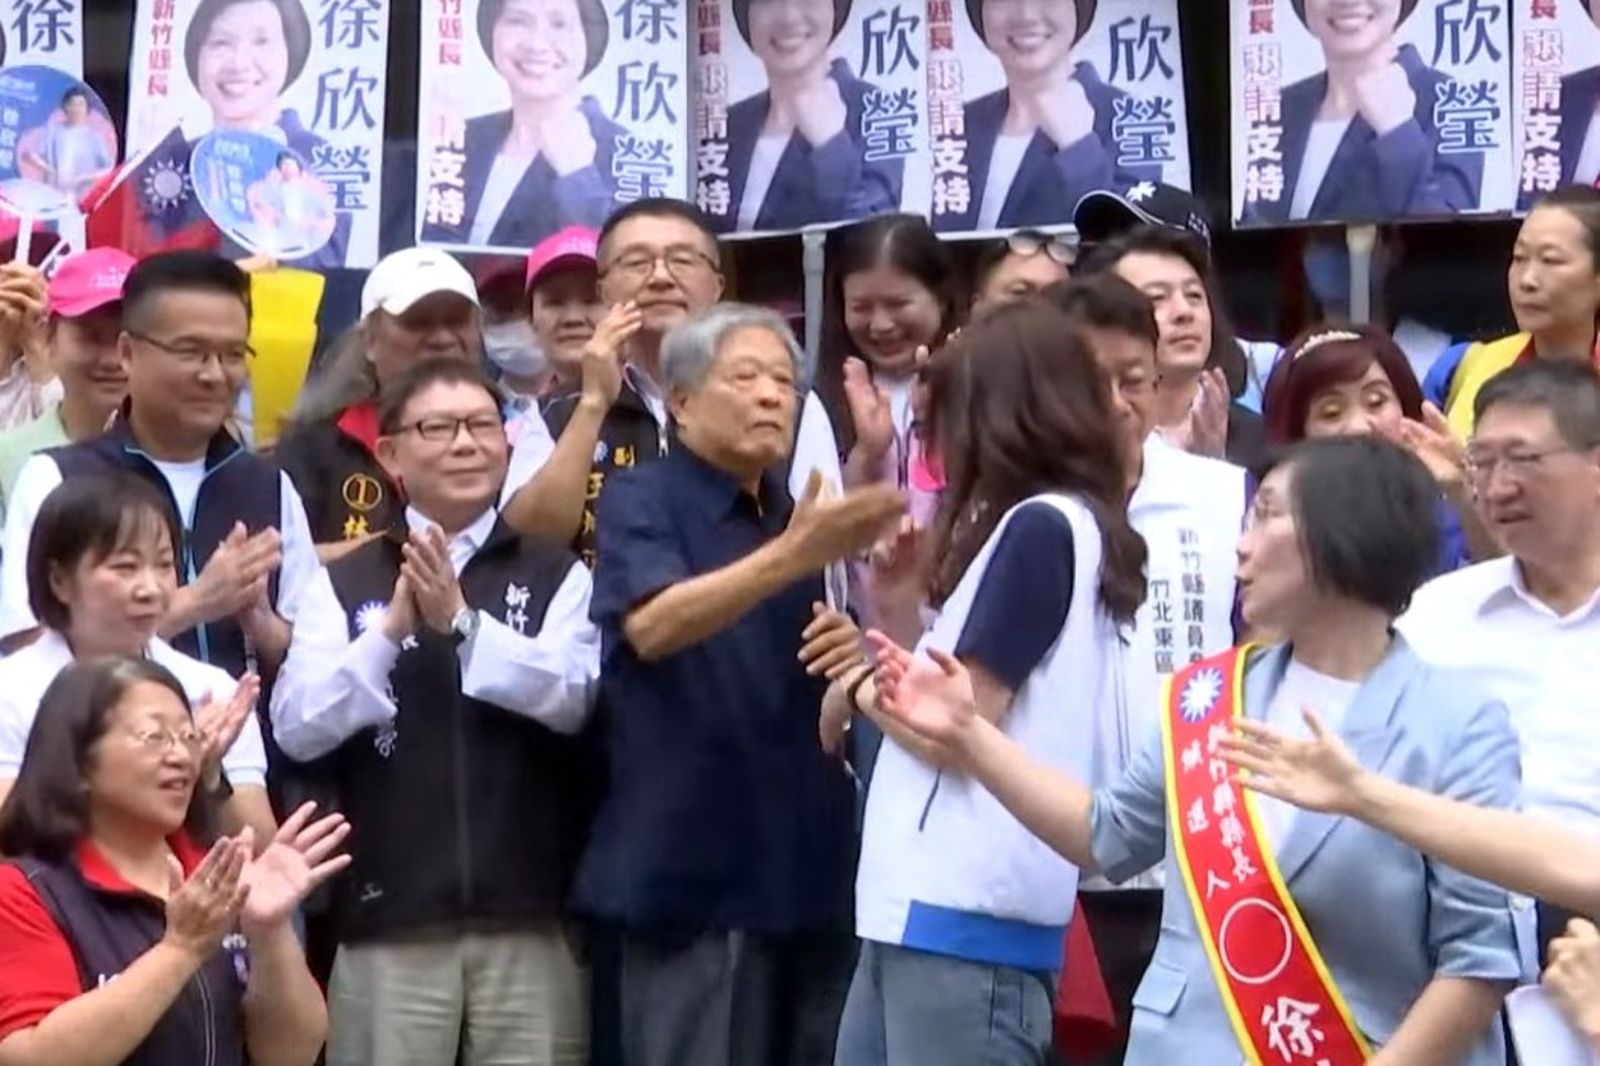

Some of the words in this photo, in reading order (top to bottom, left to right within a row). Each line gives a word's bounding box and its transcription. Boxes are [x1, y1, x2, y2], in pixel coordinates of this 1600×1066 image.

[11, 0, 75, 51] 徐
[859, 9, 920, 162] 欣瑩
[1108, 14, 1176, 167] 欣瑩
[1248, 0, 1274, 34] 長
[1432, 0, 1502, 155] 欣瑩
[310, 0, 381, 211] 徐欣瑩
[1261, 996, 1331, 1066] 徐
